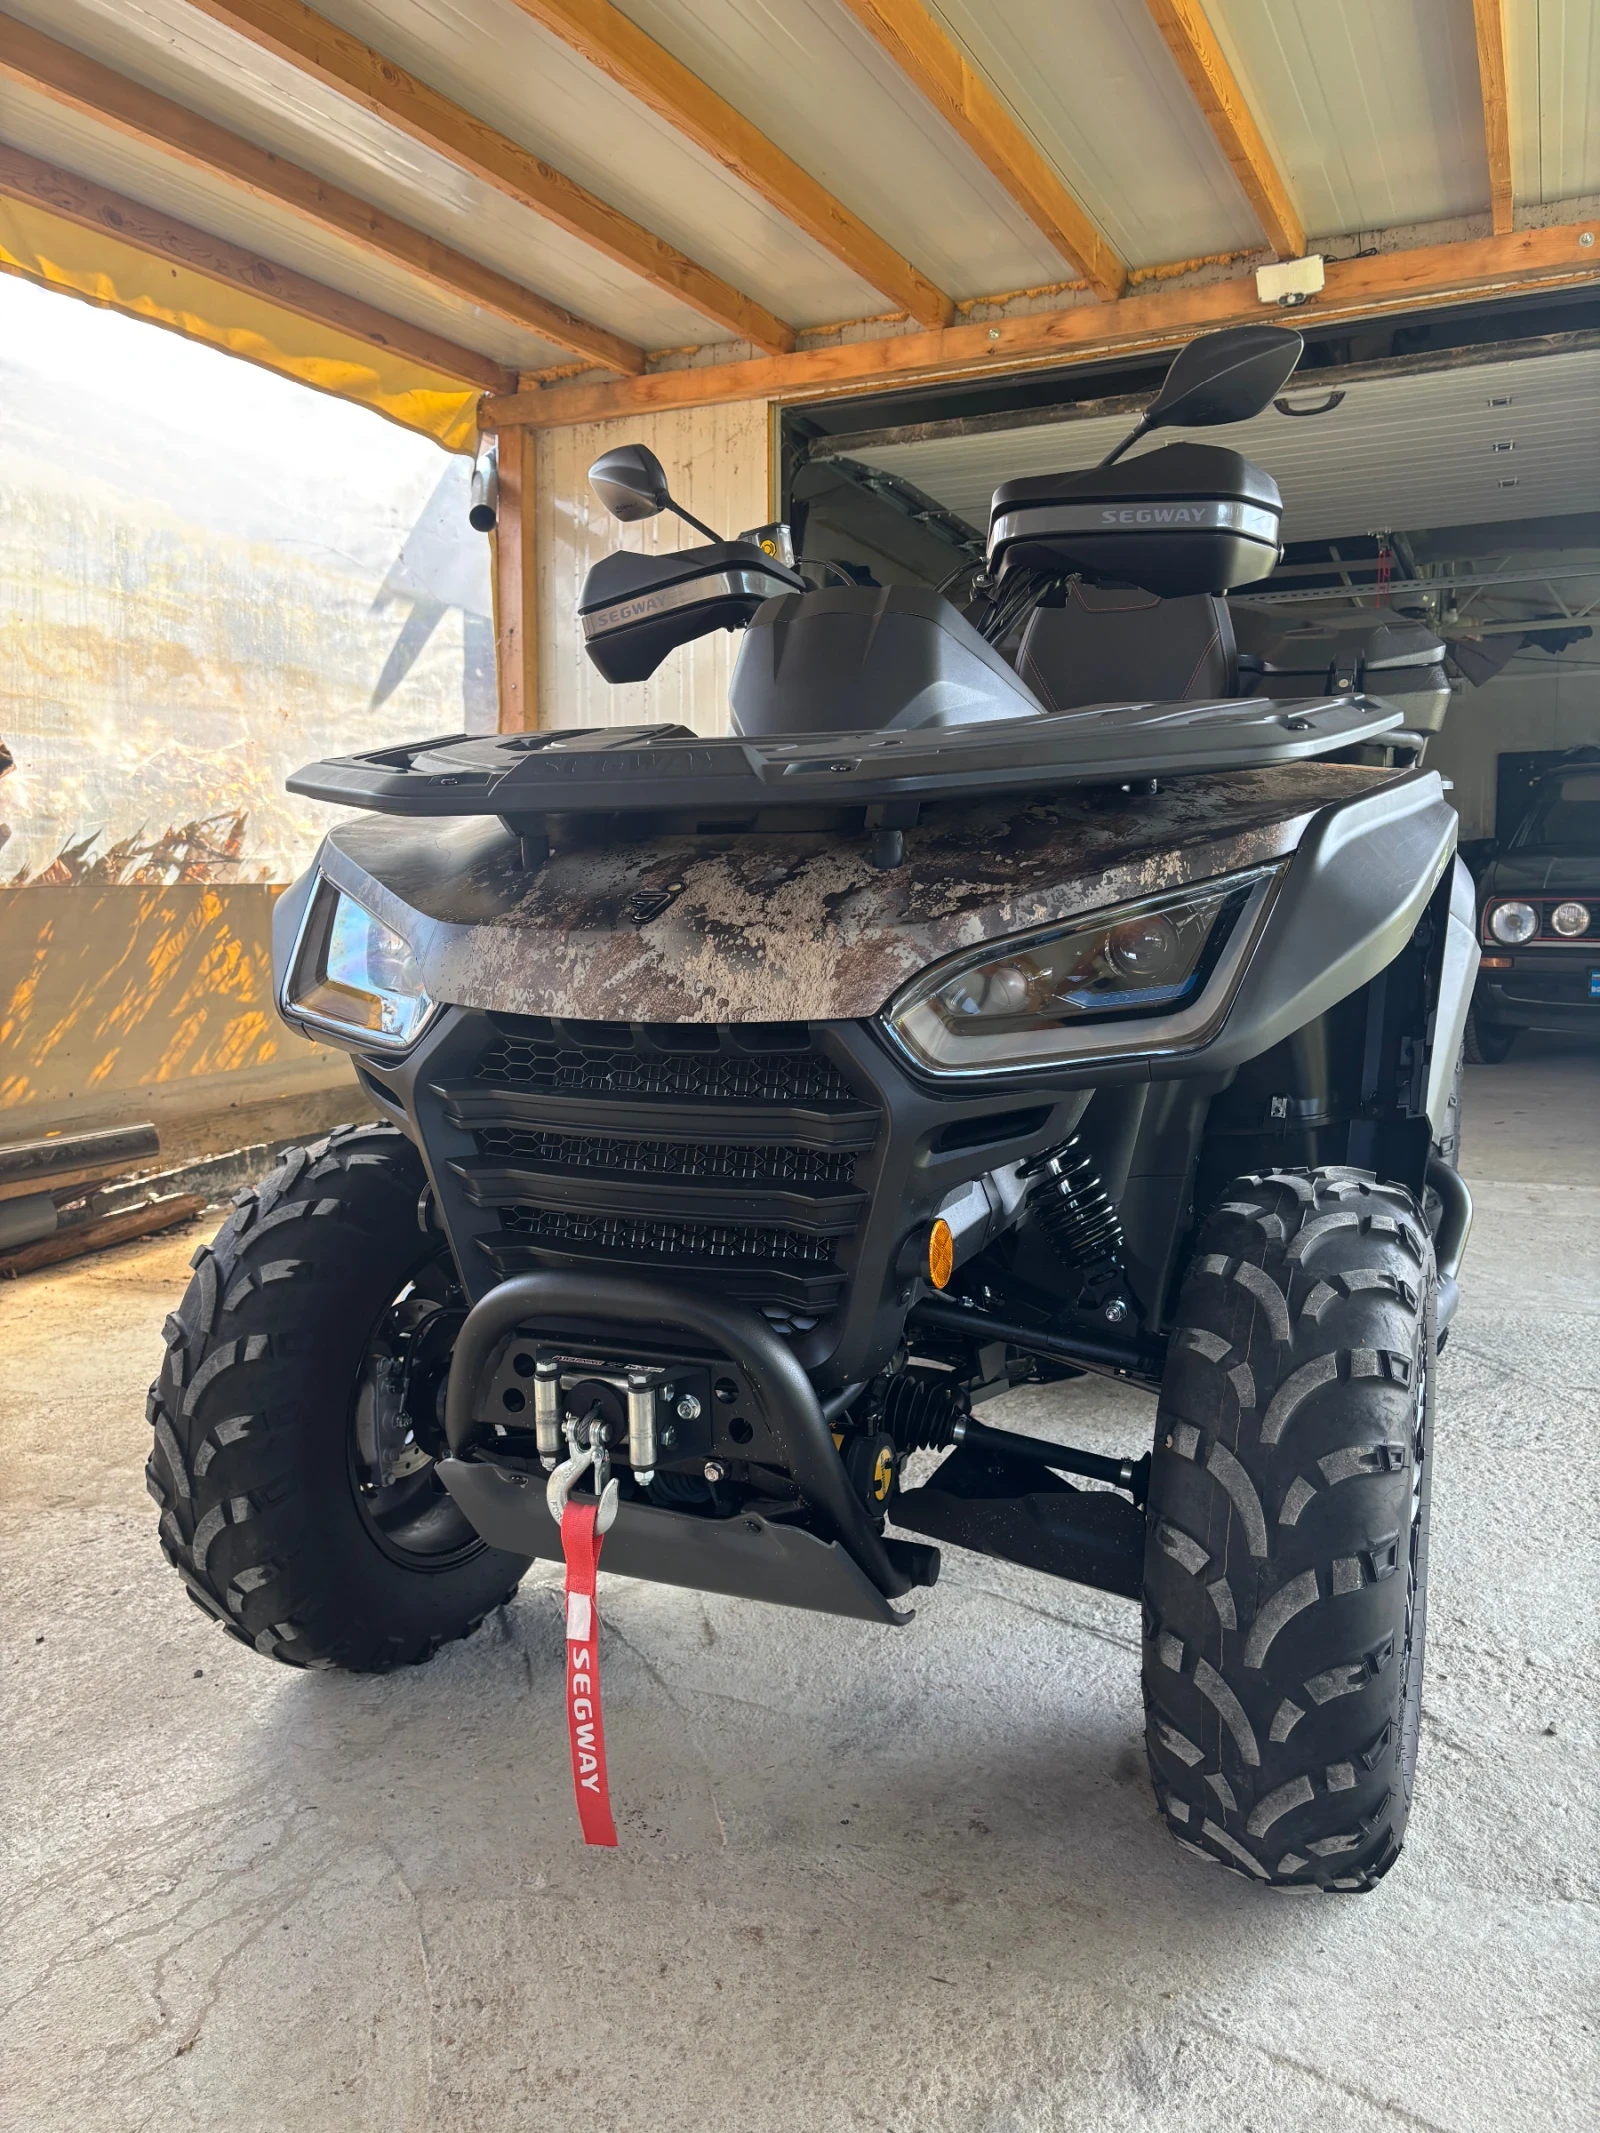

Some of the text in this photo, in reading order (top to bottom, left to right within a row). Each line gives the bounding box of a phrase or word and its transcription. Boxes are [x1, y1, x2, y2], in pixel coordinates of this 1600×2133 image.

[1101, 508, 1206, 524] SEGWAY
[598, 595, 666, 627] SEGWAY
[573, 1647, 600, 1793] SEGWAY
